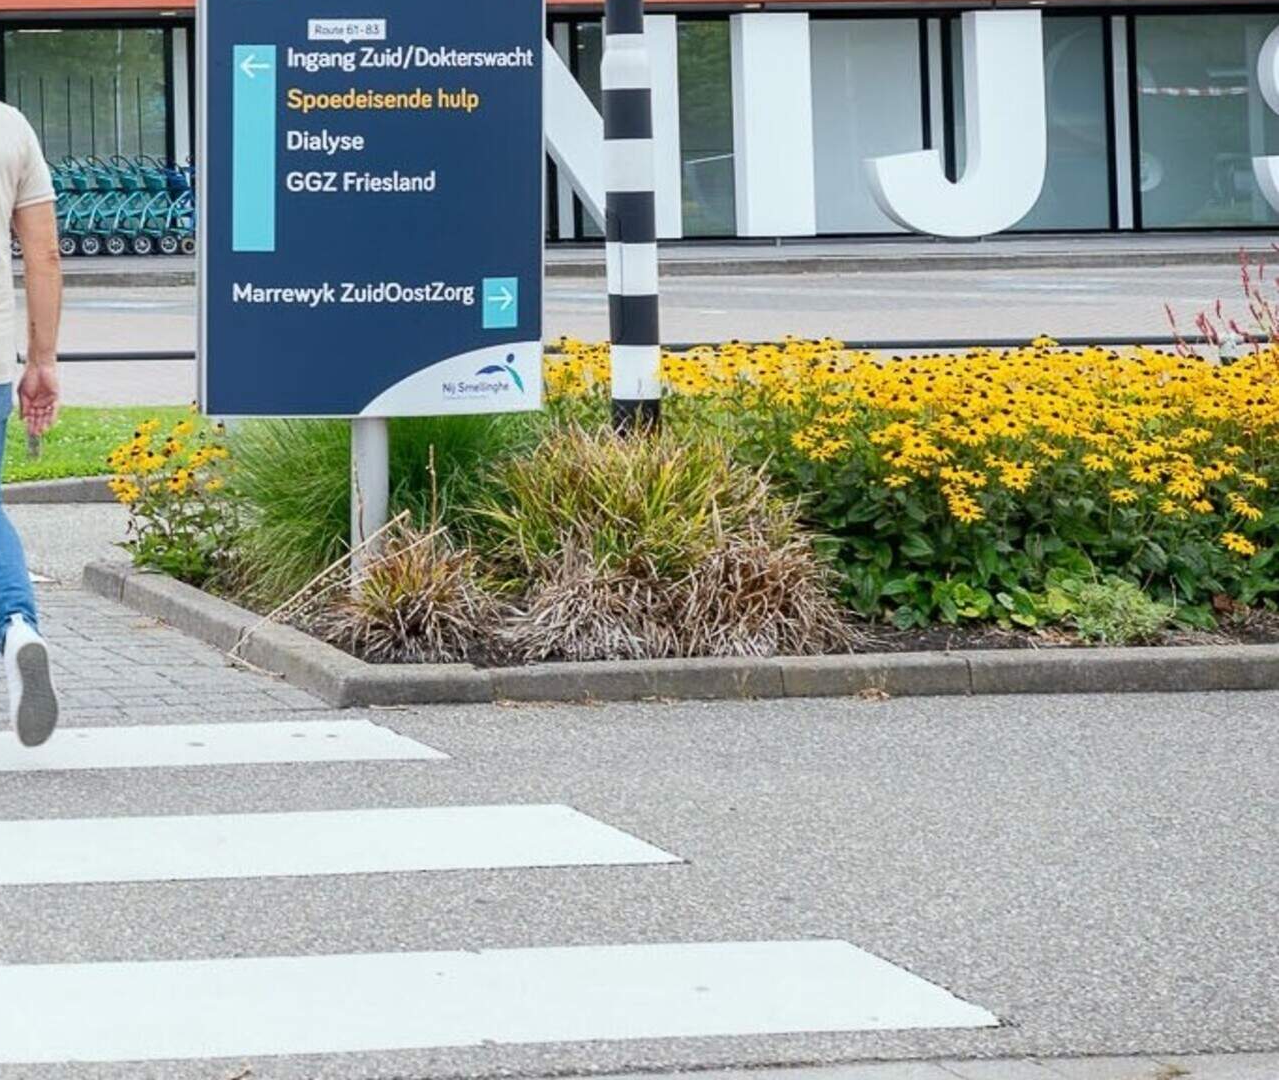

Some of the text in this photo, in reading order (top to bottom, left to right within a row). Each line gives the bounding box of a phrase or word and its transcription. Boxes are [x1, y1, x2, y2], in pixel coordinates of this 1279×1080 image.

[314, 24, 344, 35] Route
[287, 45, 534, 71] Ingang Zuid/Dokterswacht
[287, 88, 479, 113] Spoedeisende hulp
[286, 129, 365, 155] Dialyse
[286, 170, 436, 193] GGZ Friesland
[232, 282, 475, 307] Marrewyk ZuidOostZorg
